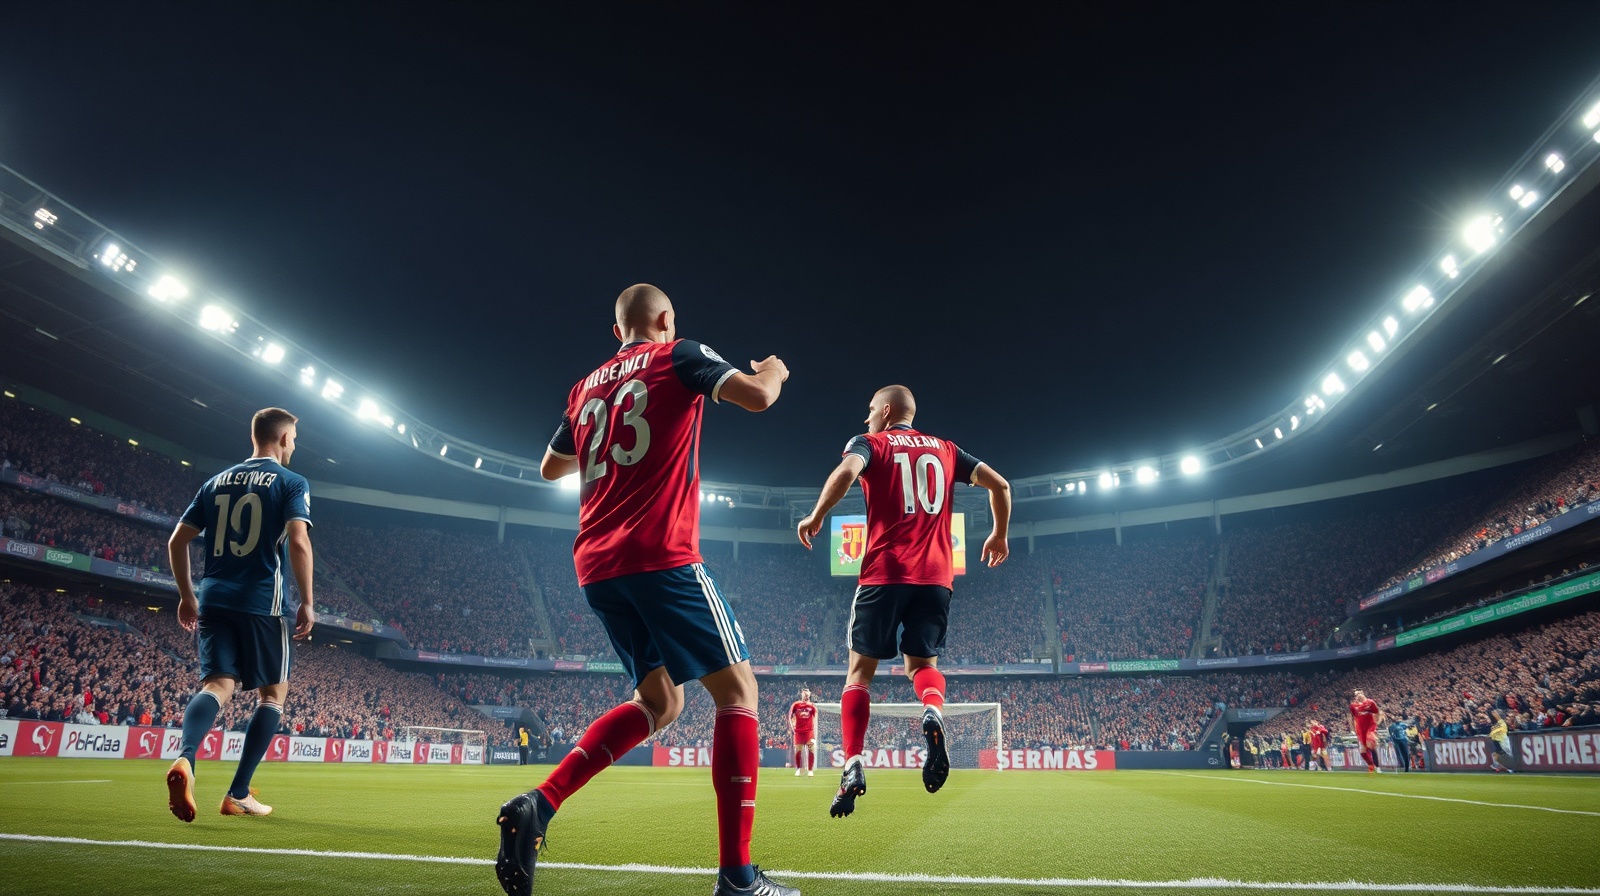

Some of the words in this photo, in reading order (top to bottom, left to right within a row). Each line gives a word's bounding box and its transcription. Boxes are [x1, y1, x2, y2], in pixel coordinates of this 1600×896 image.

[579, 379, 650, 483] 23
[894, 452, 945, 514] 10
[213, 492, 262, 557] 19
[997, 750, 1097, 769] SERMAS
